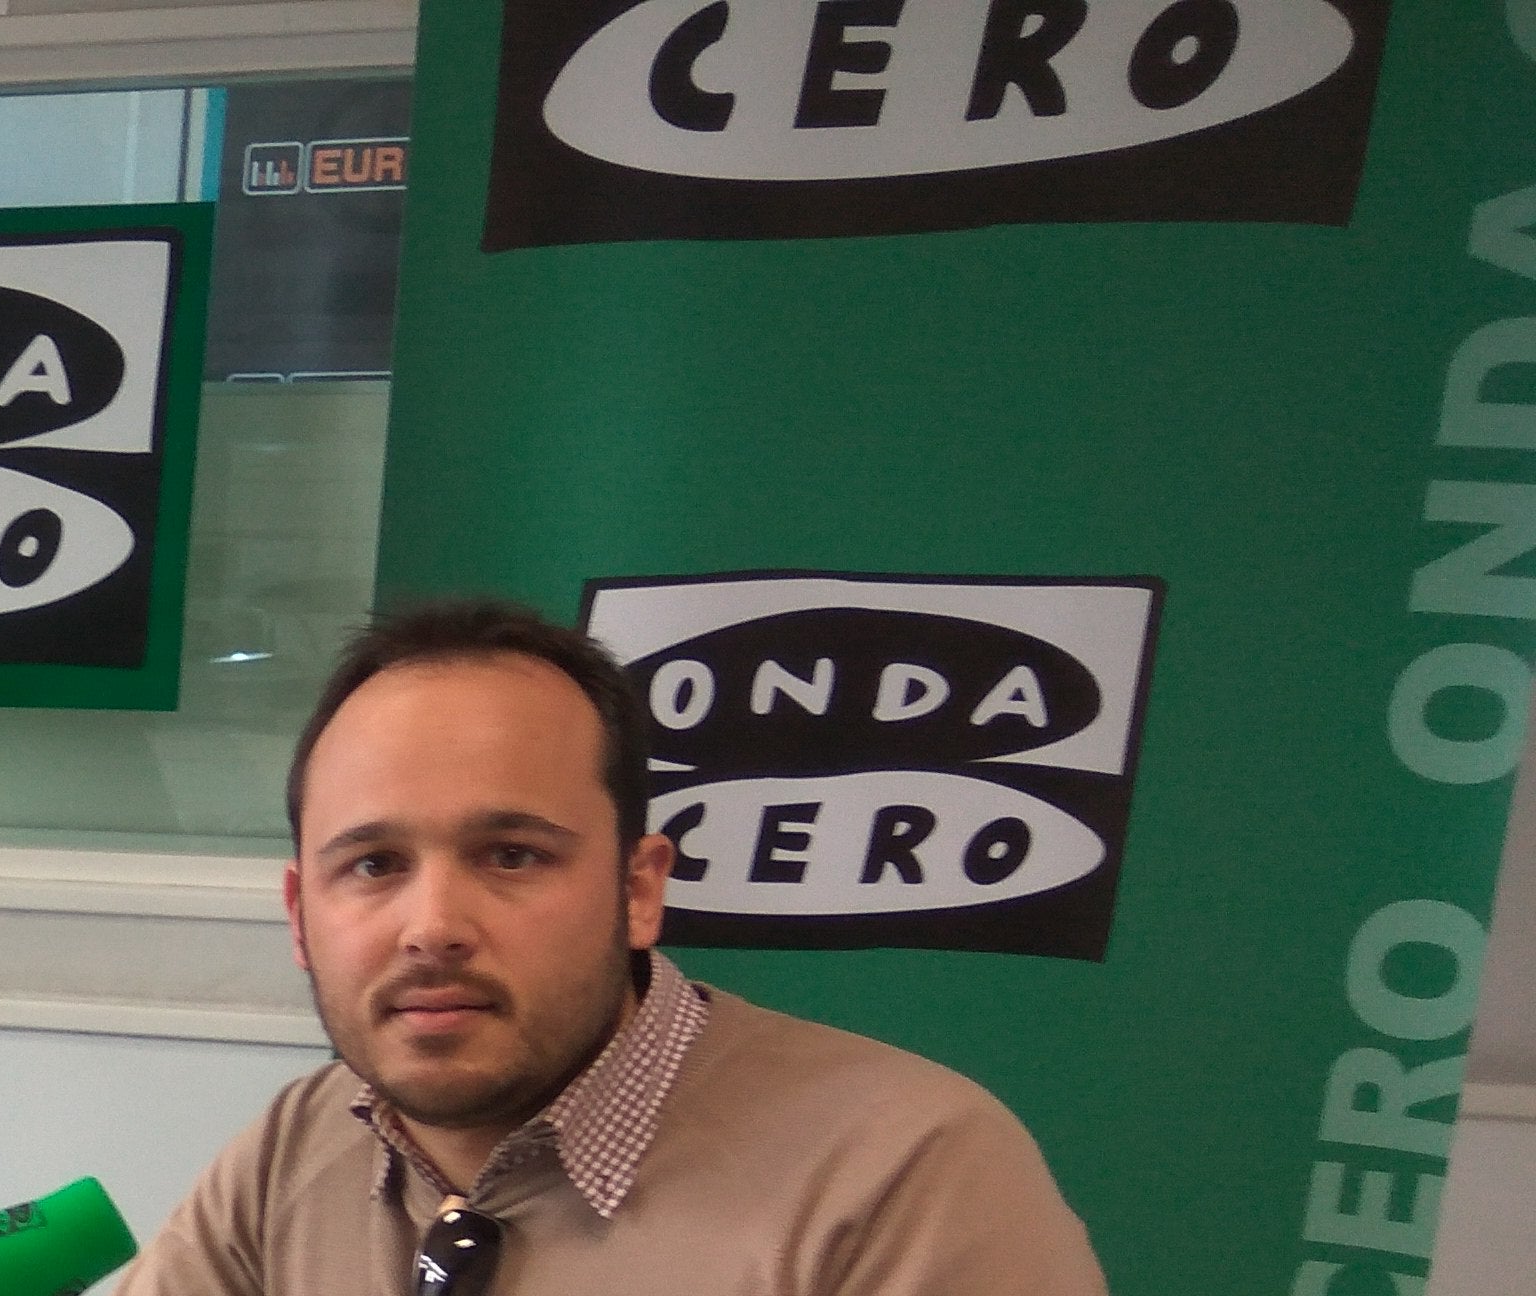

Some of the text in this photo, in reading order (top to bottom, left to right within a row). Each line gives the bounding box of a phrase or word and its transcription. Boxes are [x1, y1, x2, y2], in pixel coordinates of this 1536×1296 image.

[648, 0, 1240, 132] CERO
[649, 657, 1049, 731] ONDA
[663, 801, 1034, 886] CERO
